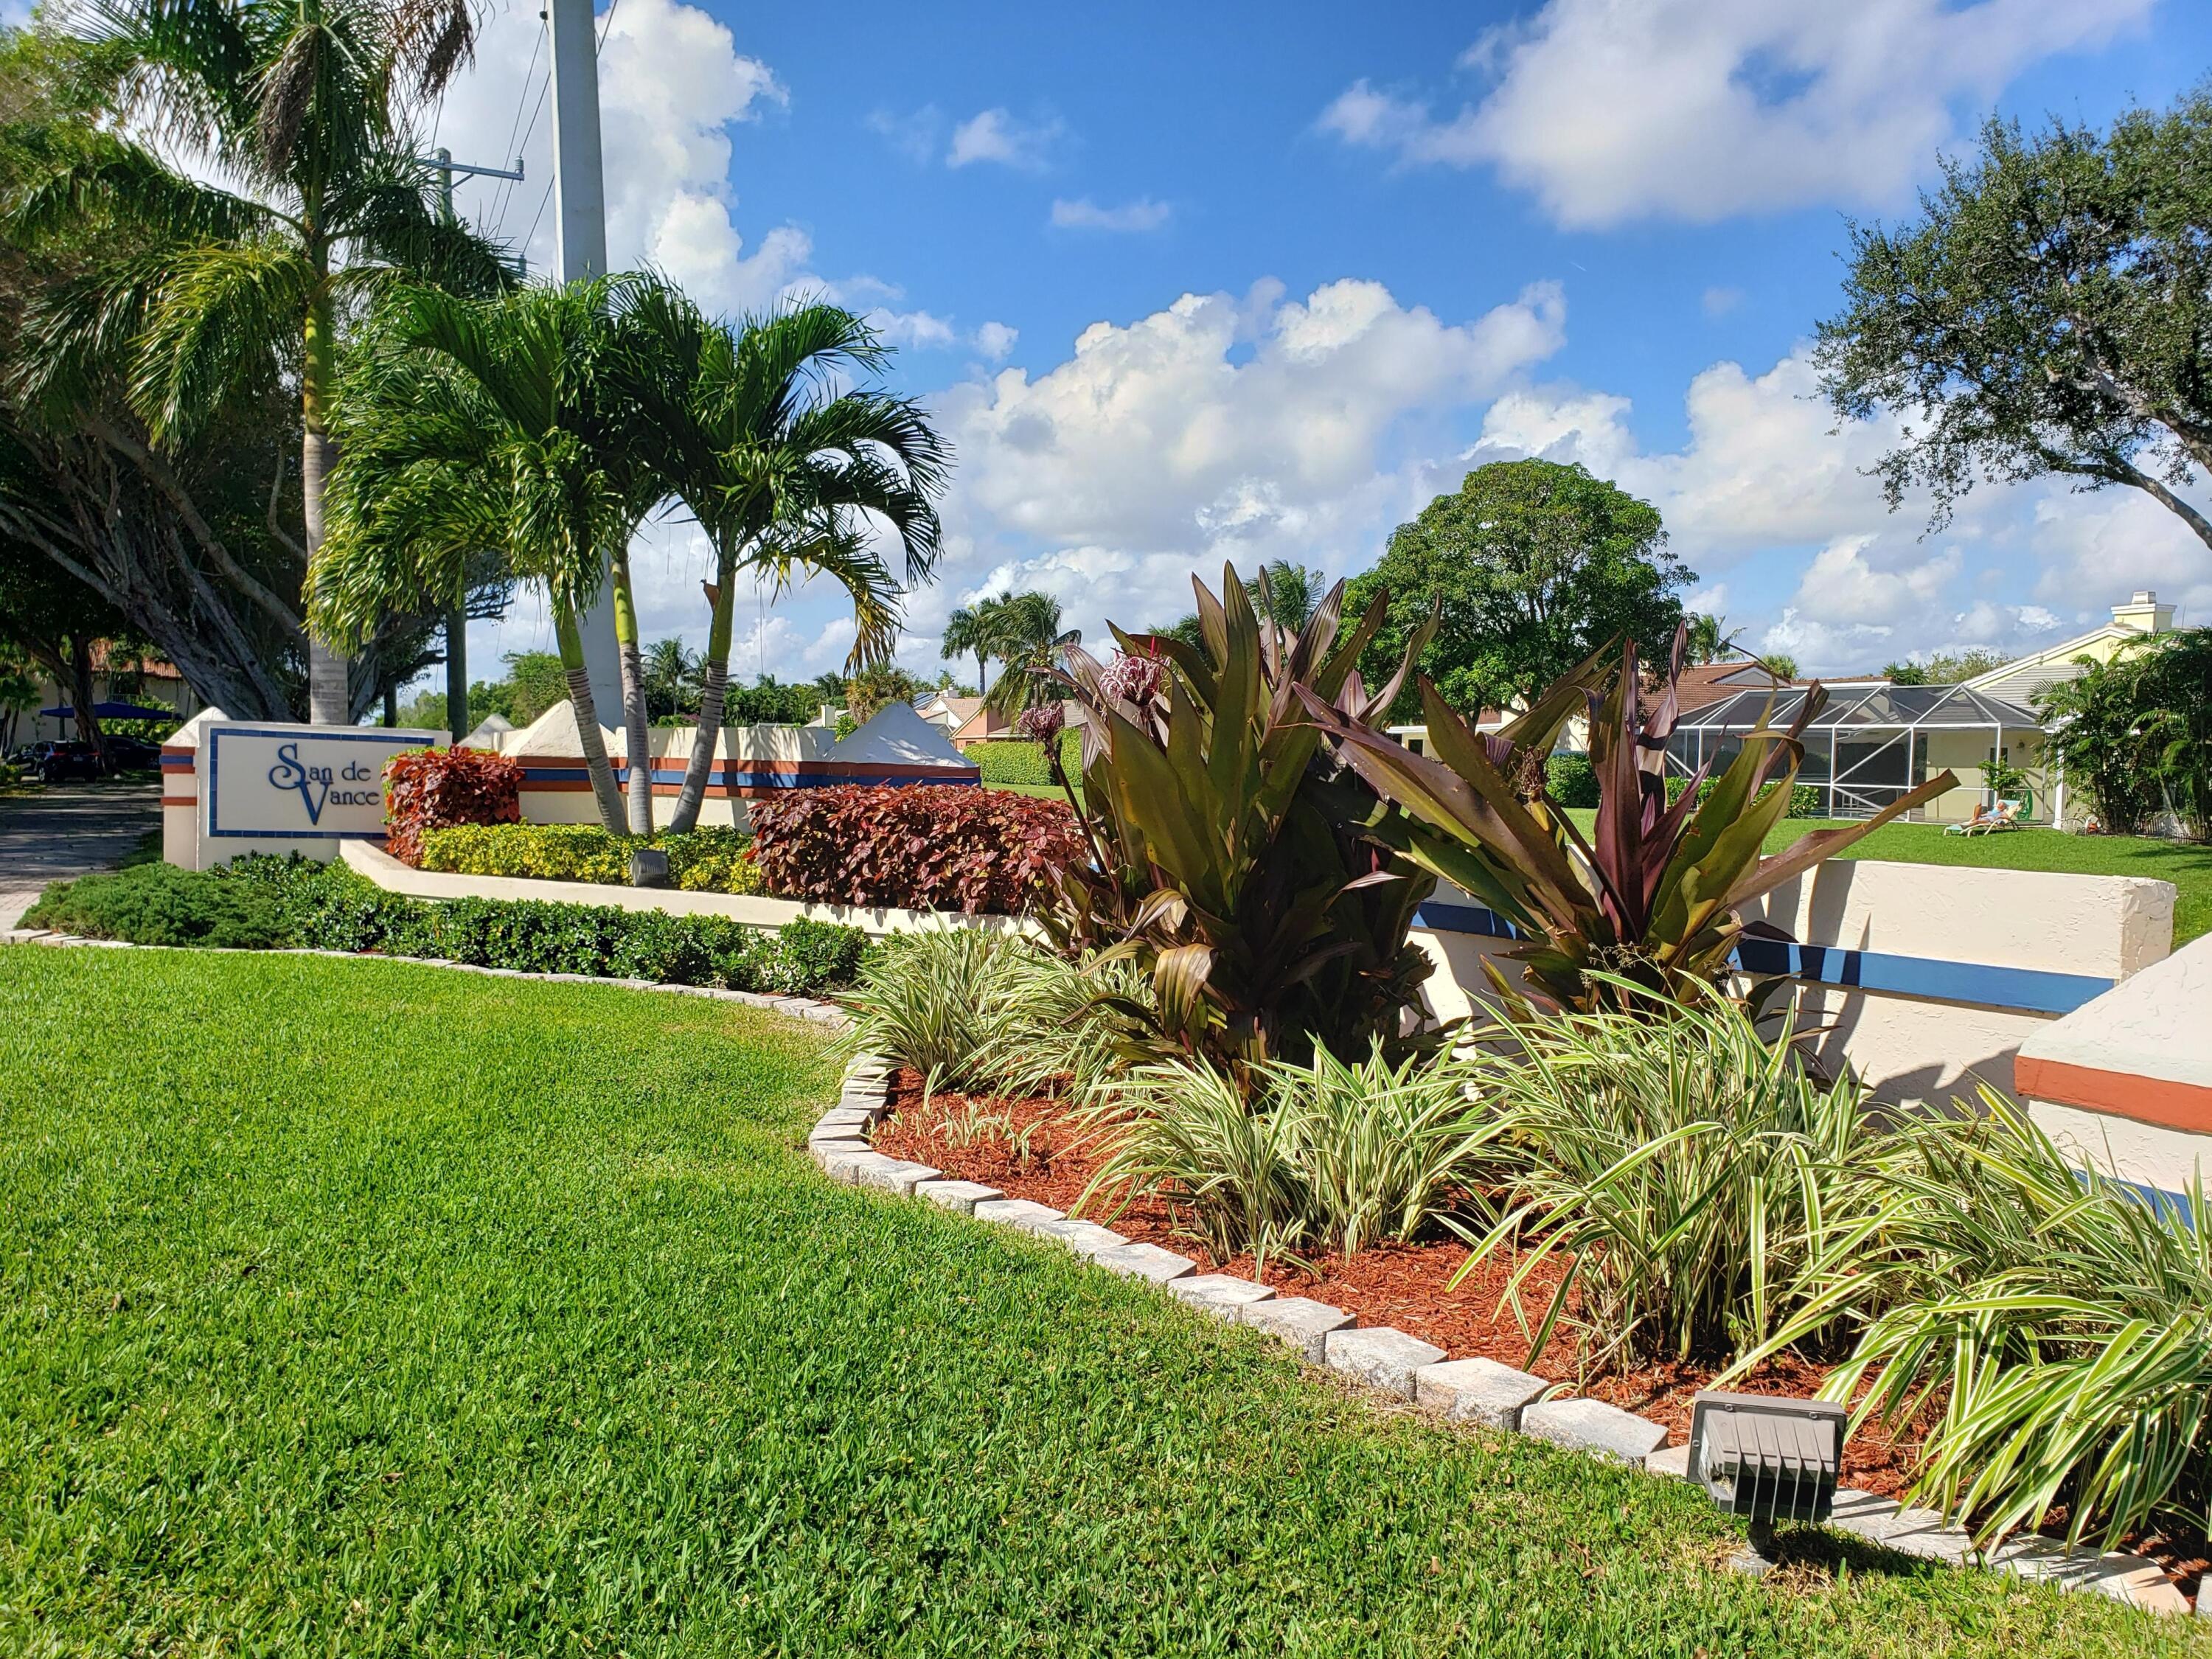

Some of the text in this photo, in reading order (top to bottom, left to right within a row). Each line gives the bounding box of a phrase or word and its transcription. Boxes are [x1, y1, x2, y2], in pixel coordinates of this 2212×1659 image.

[268, 742, 371, 790] San de
[294, 781, 380, 825] Vance
